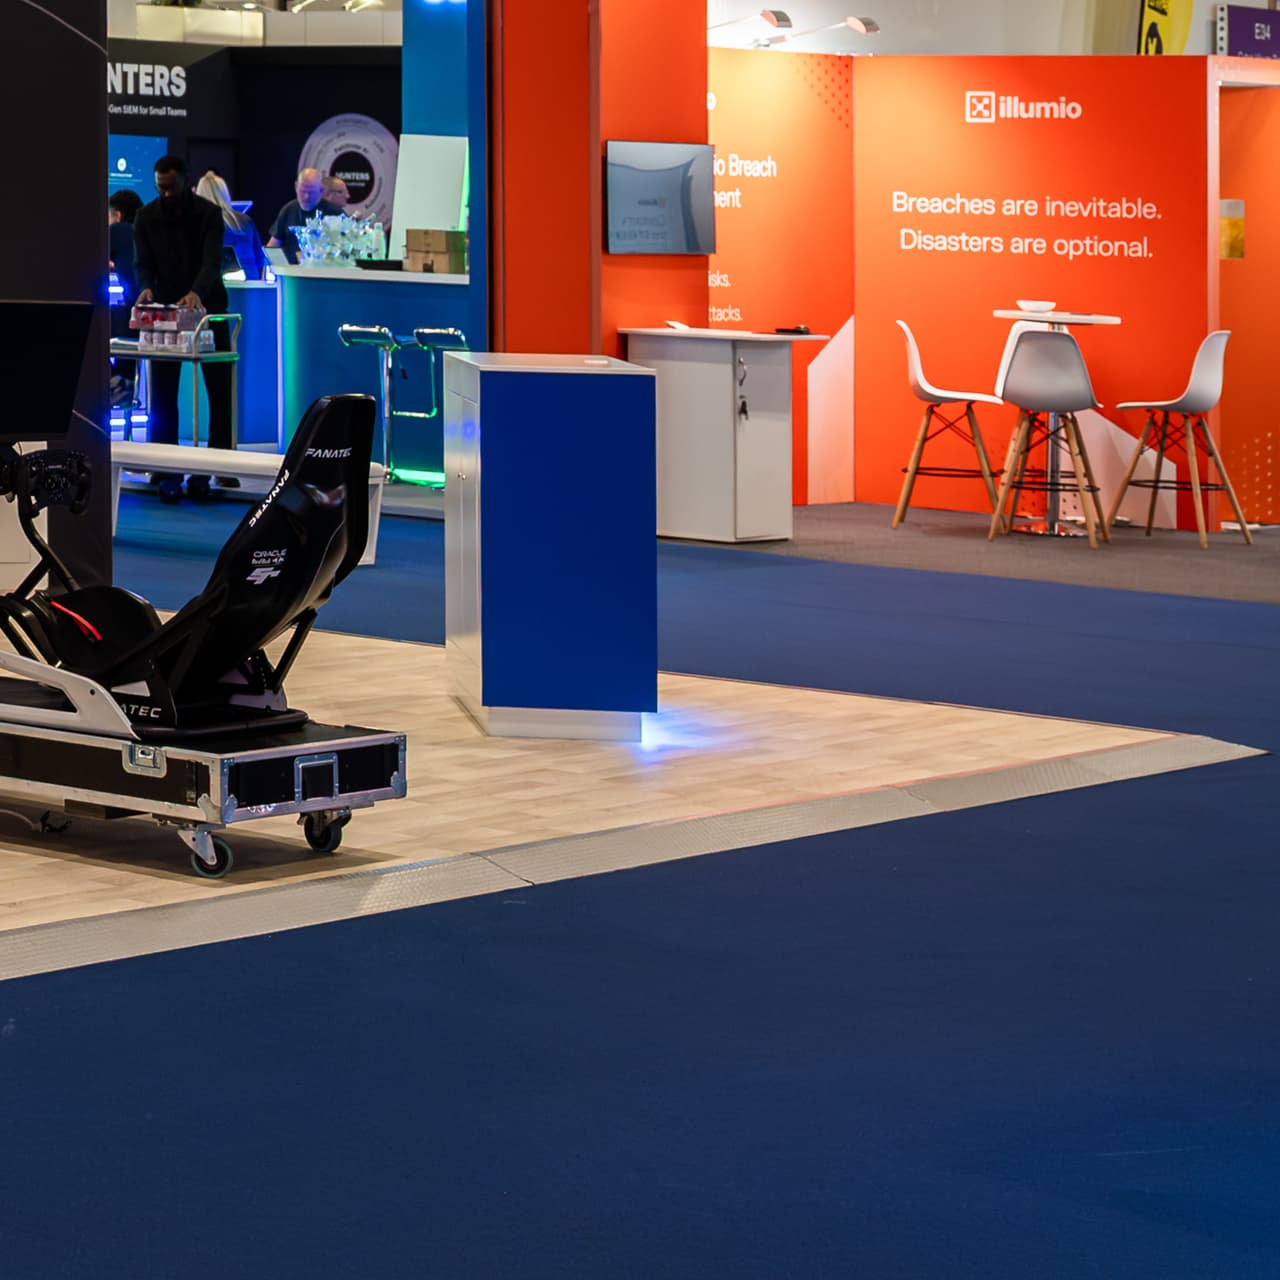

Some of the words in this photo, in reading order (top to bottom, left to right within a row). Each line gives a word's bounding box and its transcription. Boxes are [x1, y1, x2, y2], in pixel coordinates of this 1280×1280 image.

[149, 106, 166, 116] Small
[167, 107, 187, 117] Teams
[998, 97, 1083, 120] illumio
[728, 154, 777, 177] Breach
[892, 191, 995, 216] Breaches
[1002, 198, 1039, 217] are
[1044, 194, 1162, 220] inevitable.
[900, 228, 1004, 254] Disasters
[1010, 235, 1046, 255] are
[1053, 235, 1153, 259] optional.
[249, 470, 290, 527] FANATEC
